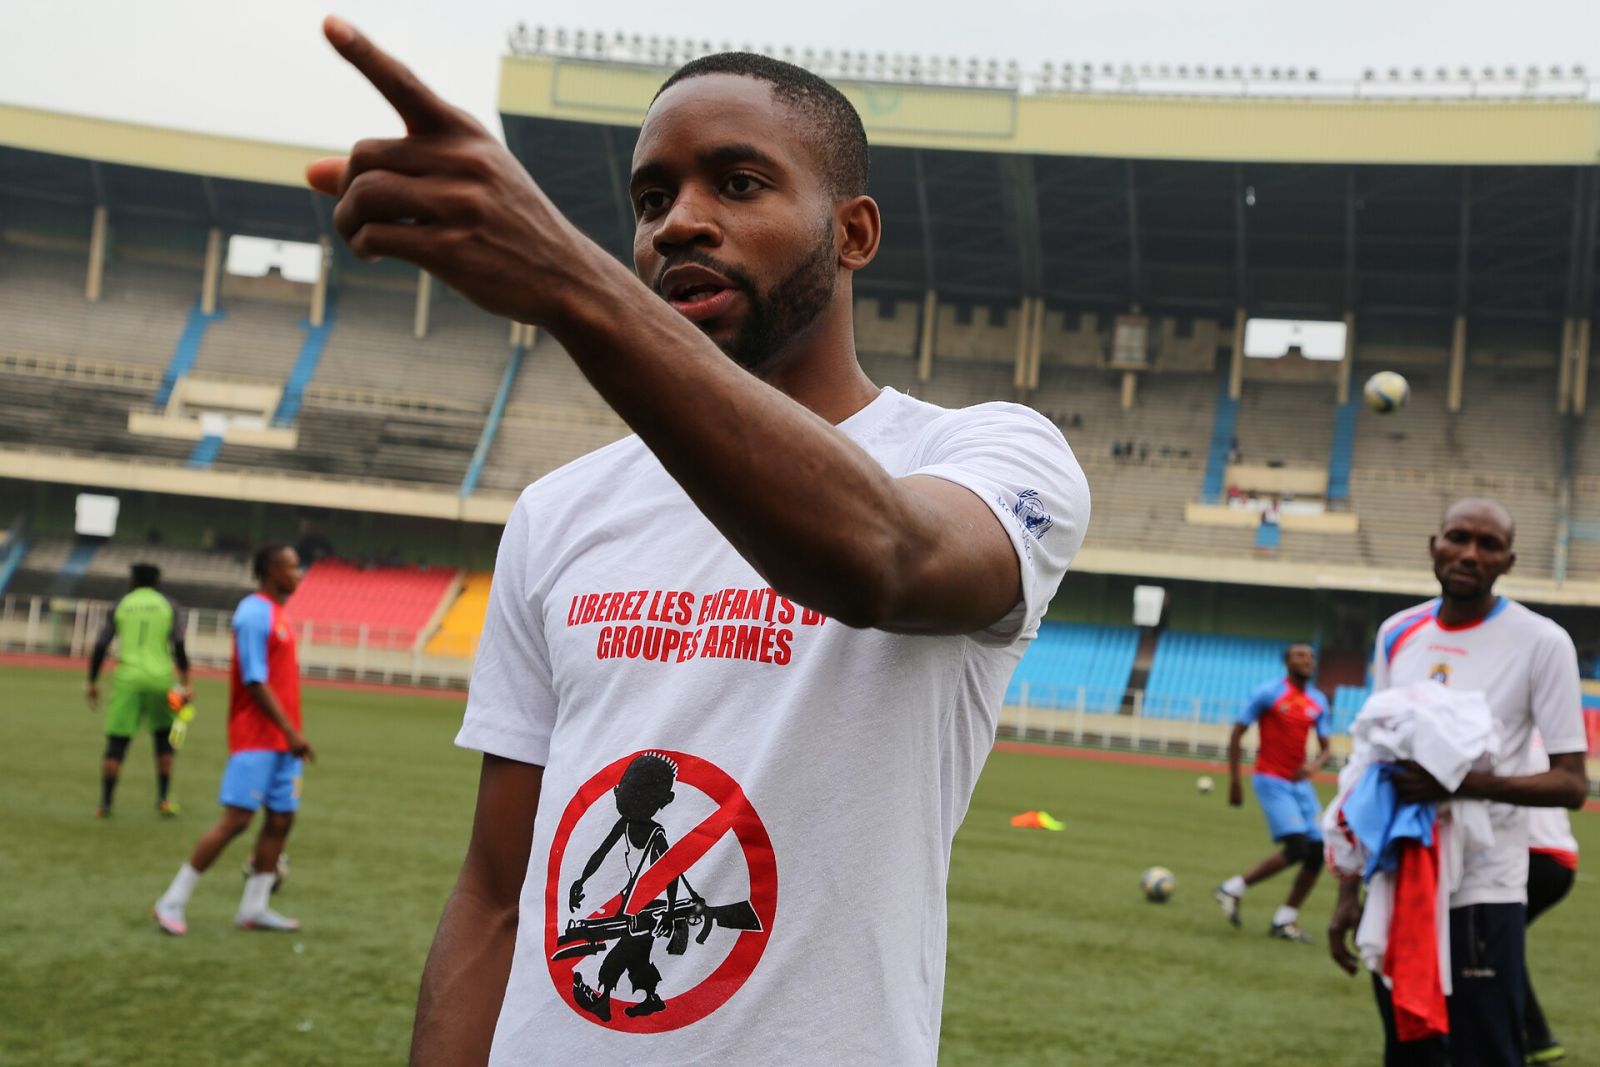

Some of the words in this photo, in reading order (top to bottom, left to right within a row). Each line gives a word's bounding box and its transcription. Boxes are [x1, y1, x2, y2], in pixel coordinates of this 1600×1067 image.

[567, 590, 650, 627] LIBEREZ
[647, 590, 696, 626] LES
[697, 586, 796, 626] ENFANTS
[596, 624, 703, 664] GROUPES
[700, 621, 794, 666] ARMÉS
